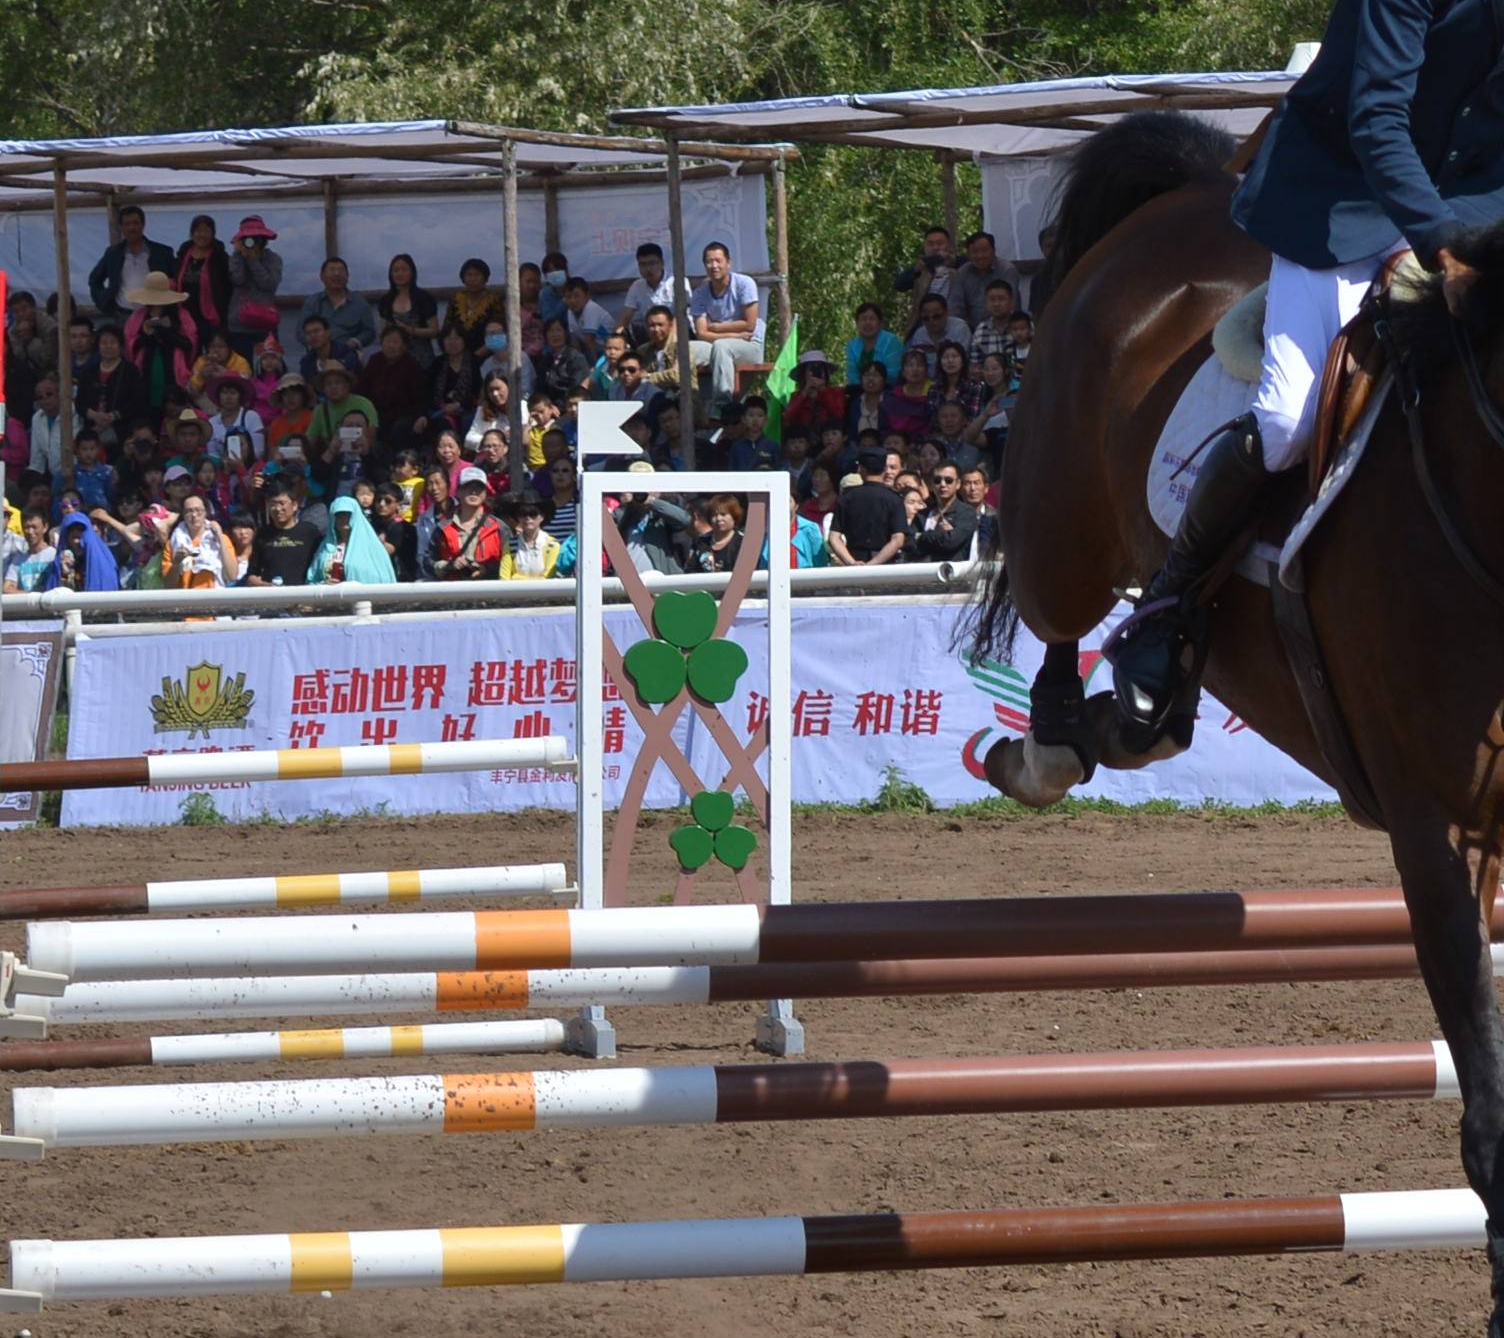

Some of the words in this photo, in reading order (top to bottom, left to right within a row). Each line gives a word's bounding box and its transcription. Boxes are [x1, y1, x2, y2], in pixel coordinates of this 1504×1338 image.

[290, 664, 446, 715] 感动世界
[852, 689, 943, 737] 和谐
